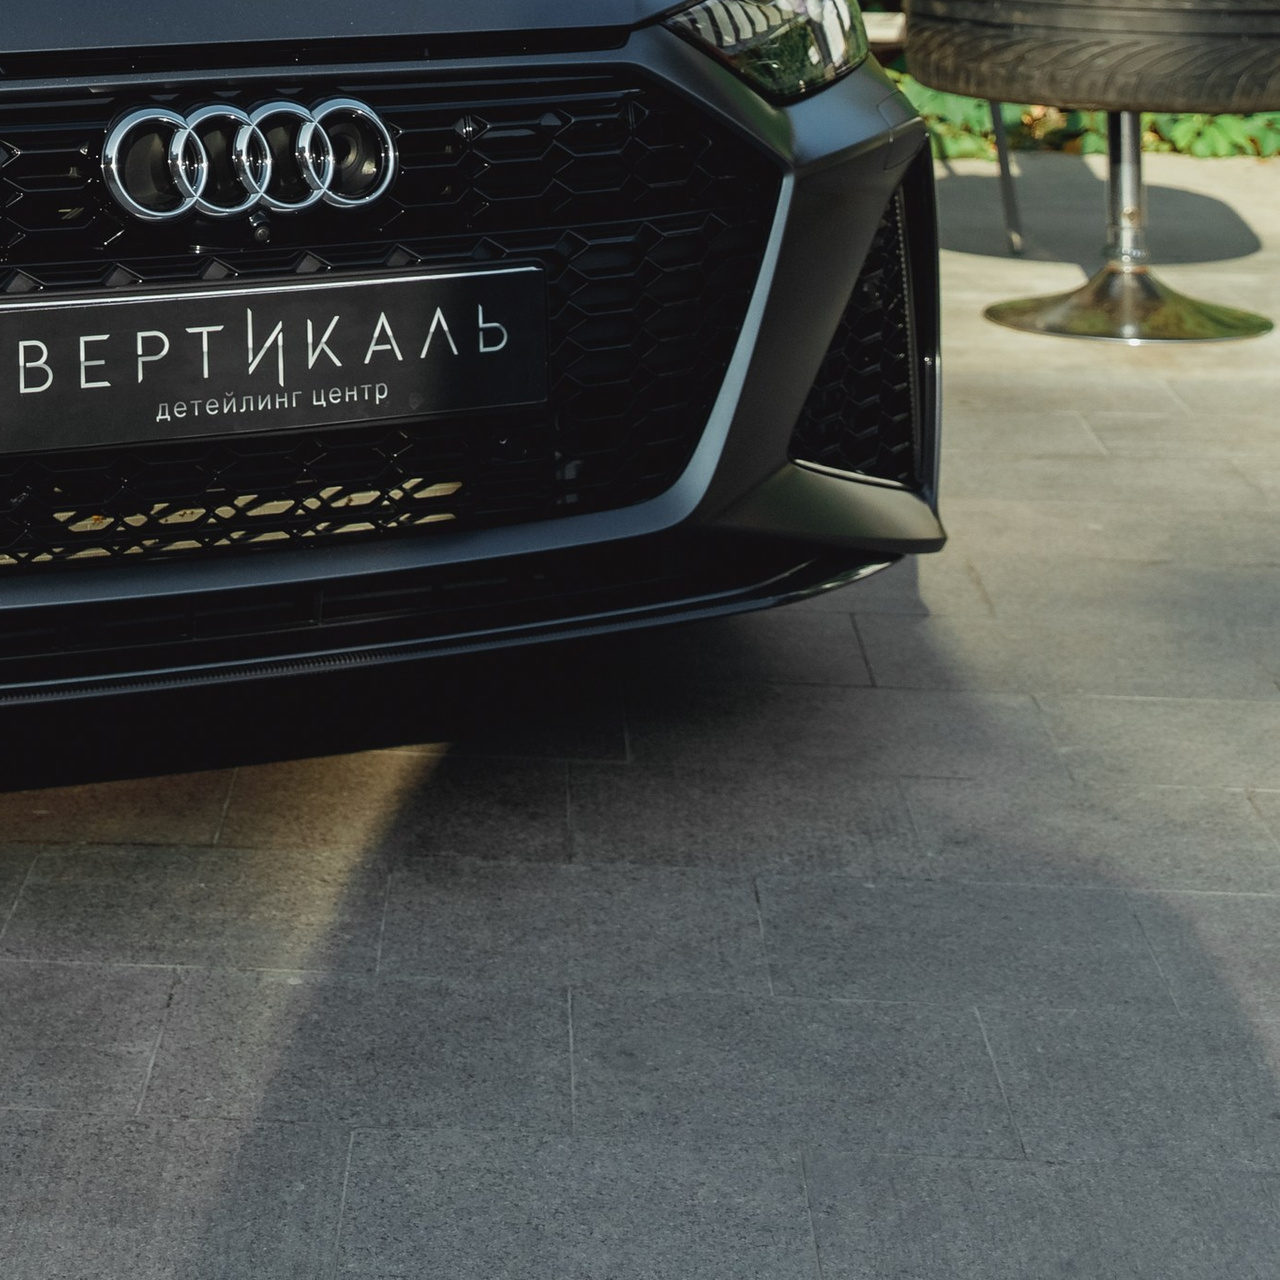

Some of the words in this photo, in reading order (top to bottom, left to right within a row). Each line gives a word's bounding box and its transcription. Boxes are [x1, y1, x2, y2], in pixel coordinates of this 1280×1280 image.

[18, 303, 509, 394] ВЕРТИКАЛЬ
[155, 389, 303, 423] детейлинг
[312, 381, 390, 409] центр
